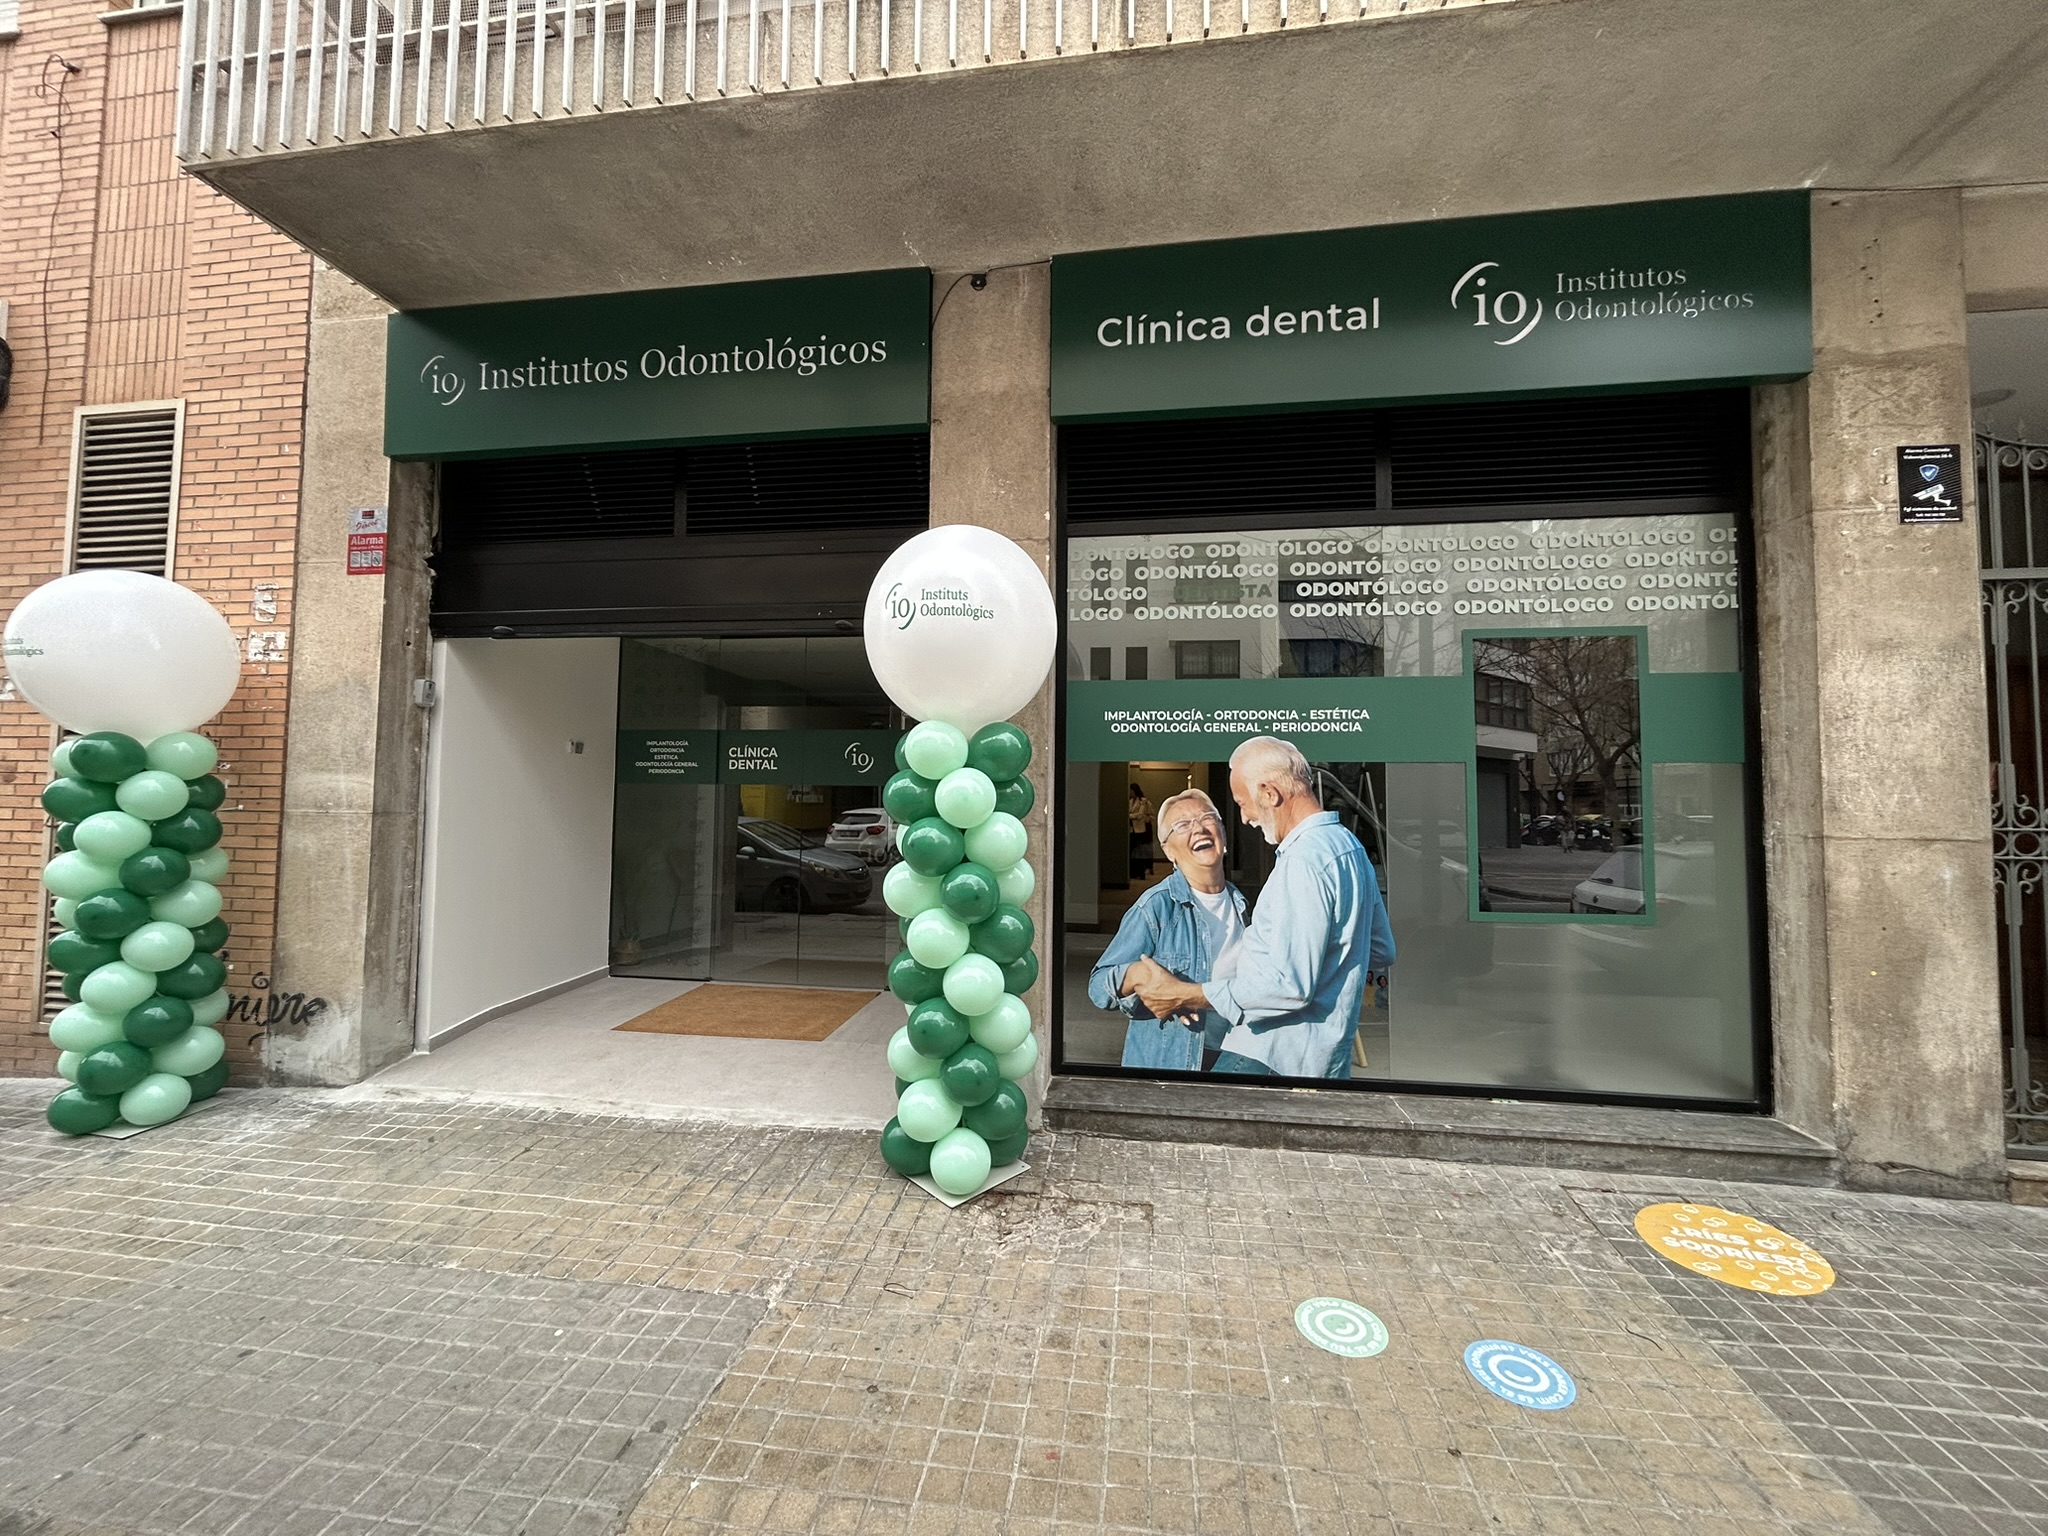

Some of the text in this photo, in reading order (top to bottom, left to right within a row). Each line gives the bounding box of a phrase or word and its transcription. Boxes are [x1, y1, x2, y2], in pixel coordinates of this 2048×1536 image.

[1556, 267, 1687, 293] Institutos
[1555, 290, 1754, 322] Odontológicos
[1097, 297, 1380, 347] Clínica dental
[478, 356, 628, 391] Institutos
[640, 334, 887, 376] Odontológicos
[350, 535, 384, 545] Alarma
[1206, 538, 1353, 558] ODONTÓLOGO
[1134, 561, 1279, 580] ODONTÓLOGO
[1290, 556, 1441, 577] ODONTÓLOGO
[921, 587, 969, 601] Instituts
[1296, 577, 1449, 597] ODONTÓLOGO
[1466, 572, 1627, 594] ODONTÓLOGO
[920, 603, 994, 621] Odontològics
[1133, 602, 1278, 620] ODONTÓLOGO
[1290, 598, 1442, 618] ODONTÓLOGO
[1454, 594, 1614, 615] ODONTÓLOGO
[1104, 708, 1204, 721] IMPLANTOLOGÍA
[1214, 710, 1299, 720] ORTODONCIA
[1309, 707, 1370, 720] ESTÉTICA
[1110, 720, 1201, 733] ODONTOLOGÍA
[1204, 722, 1261, 733] GENERAL
[1272, 721, 1362, 733] PERIODONCIA
[728, 744, 778, 758] CLÍNICA
[728, 759, 778, 770] DENTAL
